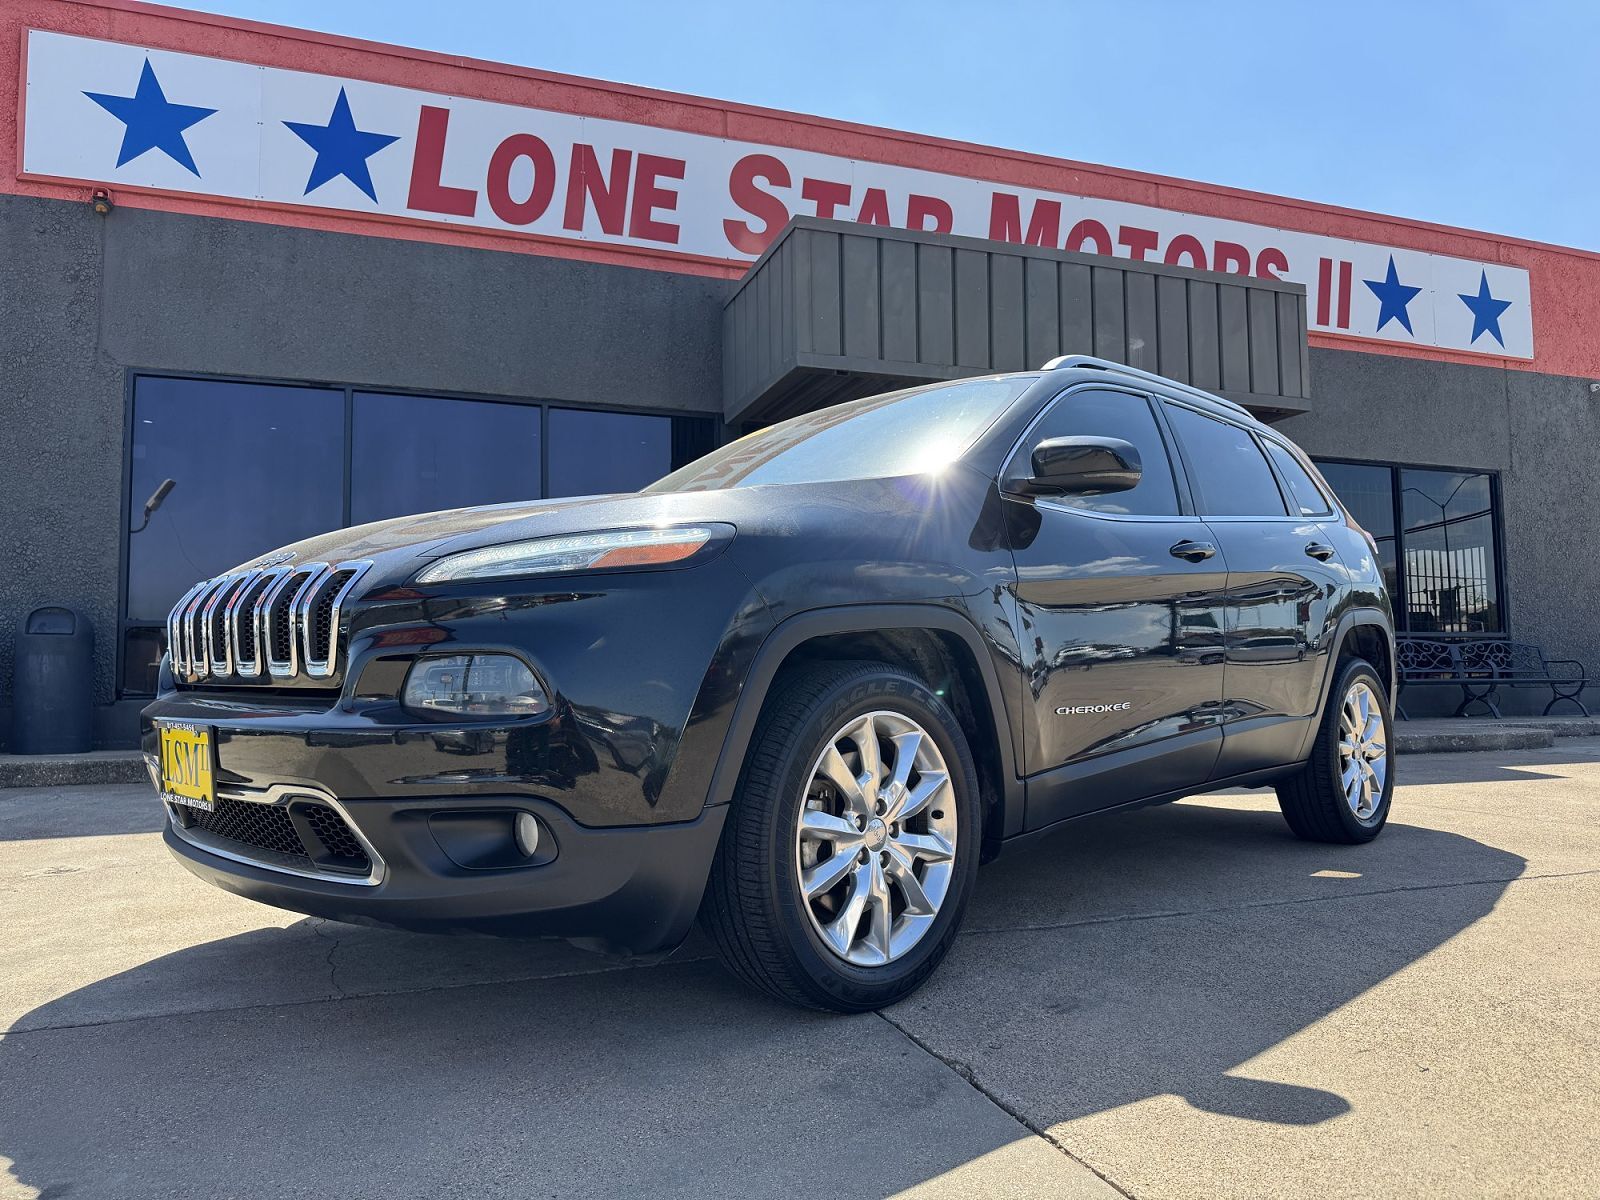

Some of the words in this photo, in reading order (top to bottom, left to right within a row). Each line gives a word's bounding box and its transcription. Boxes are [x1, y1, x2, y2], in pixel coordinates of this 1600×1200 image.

[408, 105, 686, 245] LONE
[1317, 257, 1353, 329] II
[821, 680, 900, 731] EAGLE
[1055, 701, 1131, 715] CHEROKEE
[174, 796, 187, 806] STAR
[187, 799, 208, 810] MOTORS
